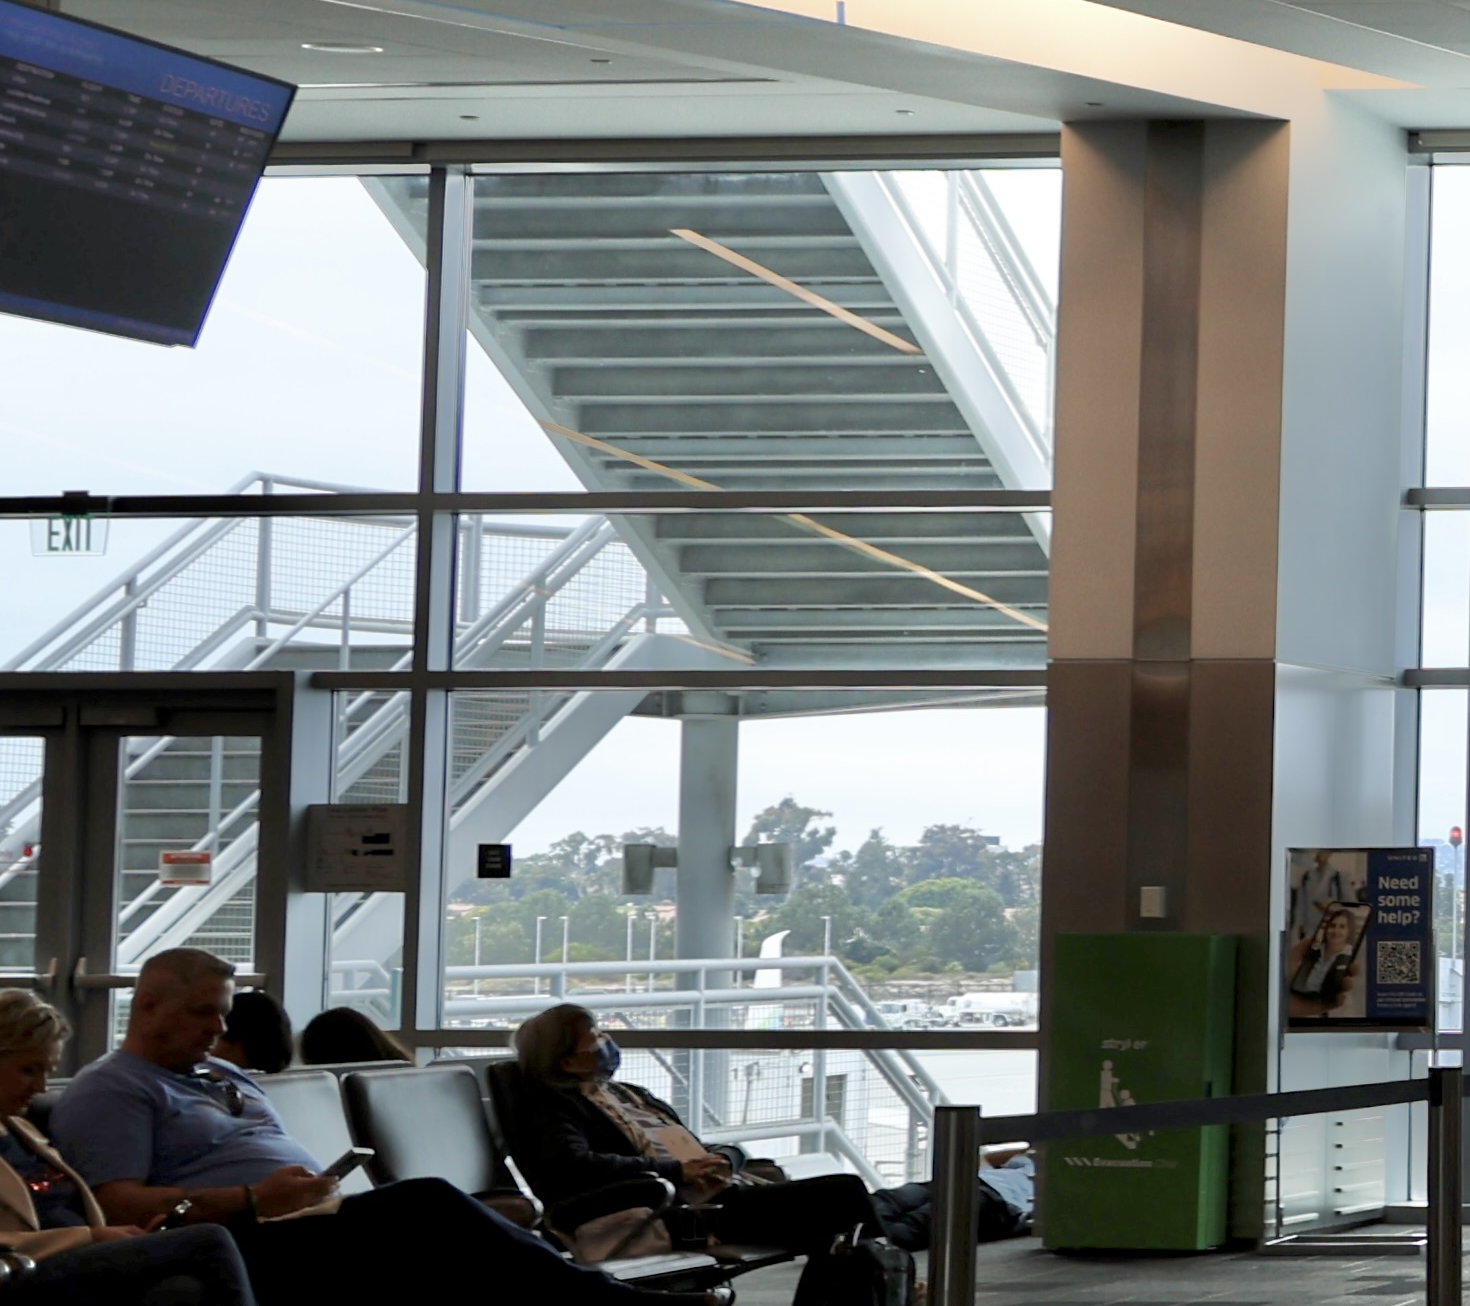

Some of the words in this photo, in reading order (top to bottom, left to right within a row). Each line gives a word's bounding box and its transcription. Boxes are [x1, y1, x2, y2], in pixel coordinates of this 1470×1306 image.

[160, 73, 270, 122] DEPARTURES
[47, 515, 96, 551] EXIT
[1378, 876, 1419, 889] Need
[1377, 895, 1420, 906] some
[1377, 910, 1420, 926] help?
